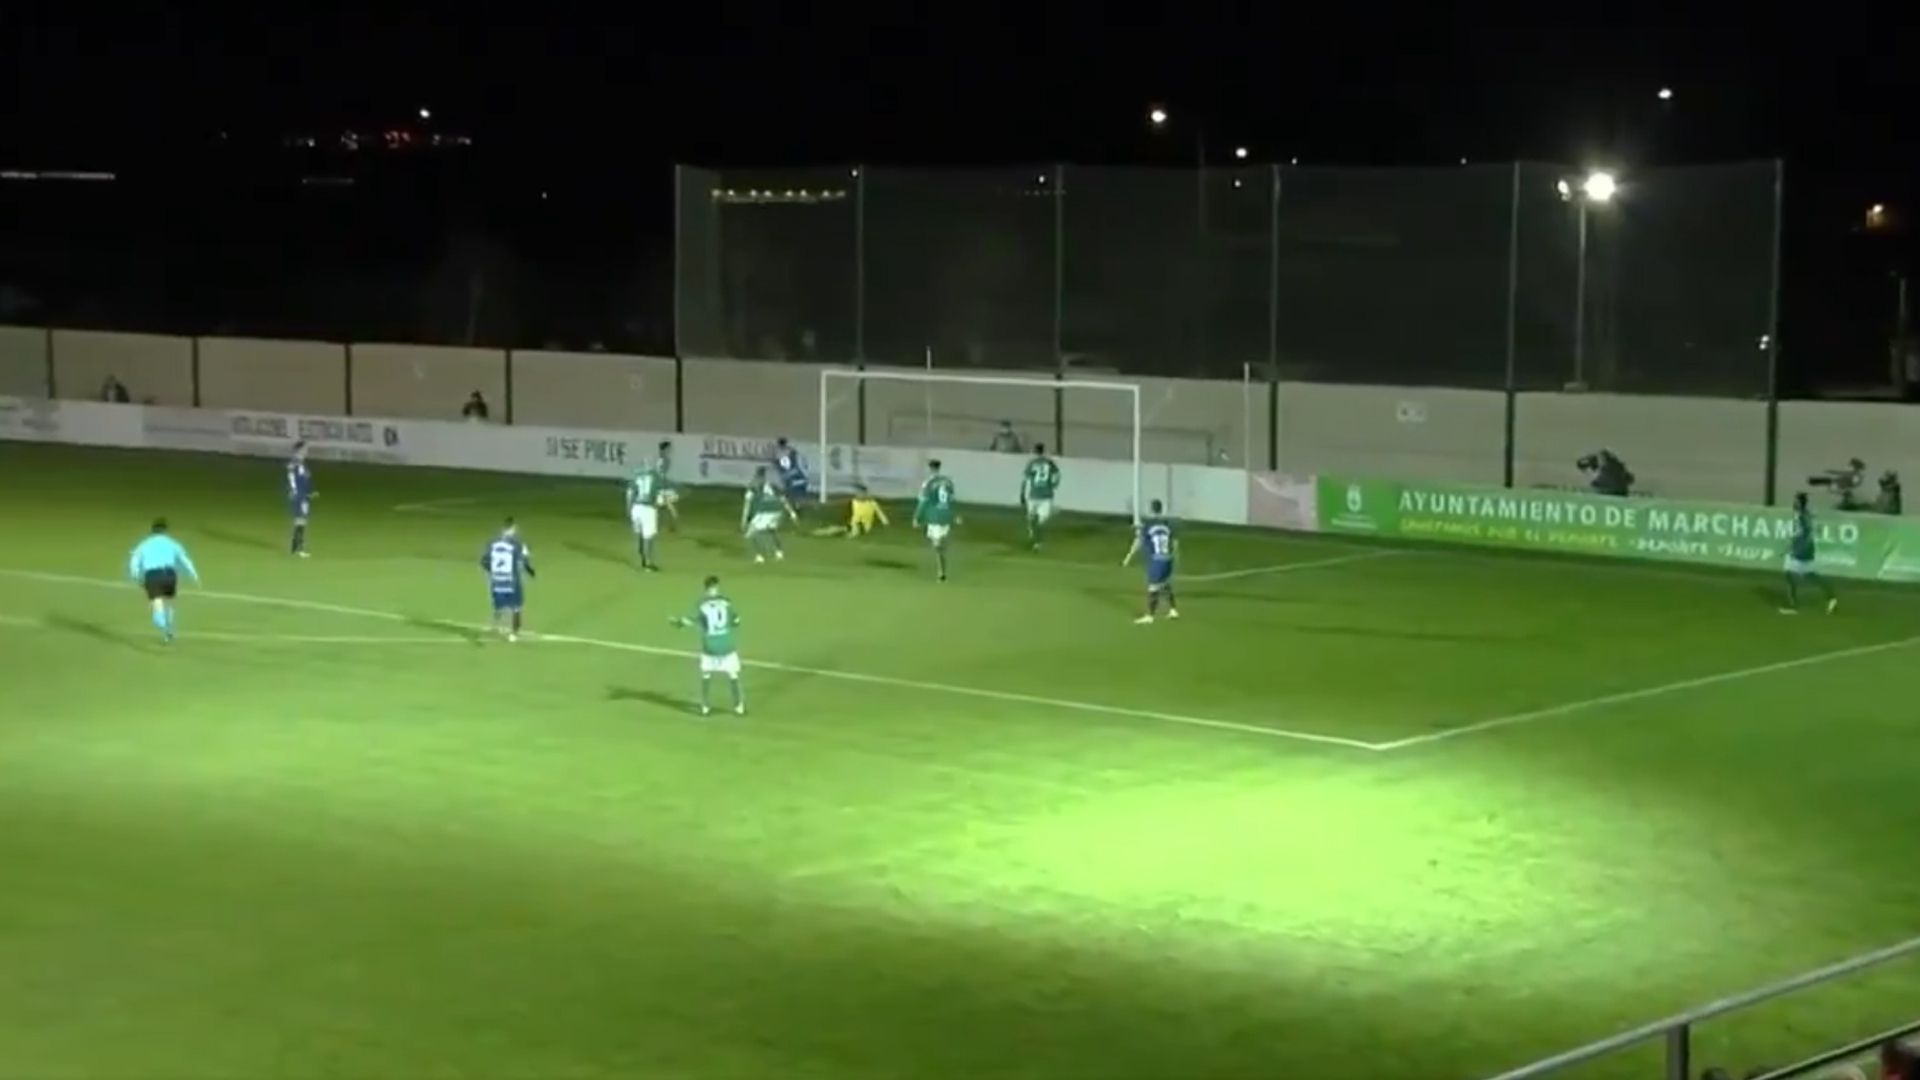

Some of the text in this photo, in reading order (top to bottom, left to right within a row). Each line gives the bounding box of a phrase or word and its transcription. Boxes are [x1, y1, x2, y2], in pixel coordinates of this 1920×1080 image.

[1399, 489, 1597, 525] AYUNTAMIENTO
[1605, 505, 1636, 529] DE
[1648, 508, 1859, 544] MARCHAMLO
[701, 604, 728, 632] 10
